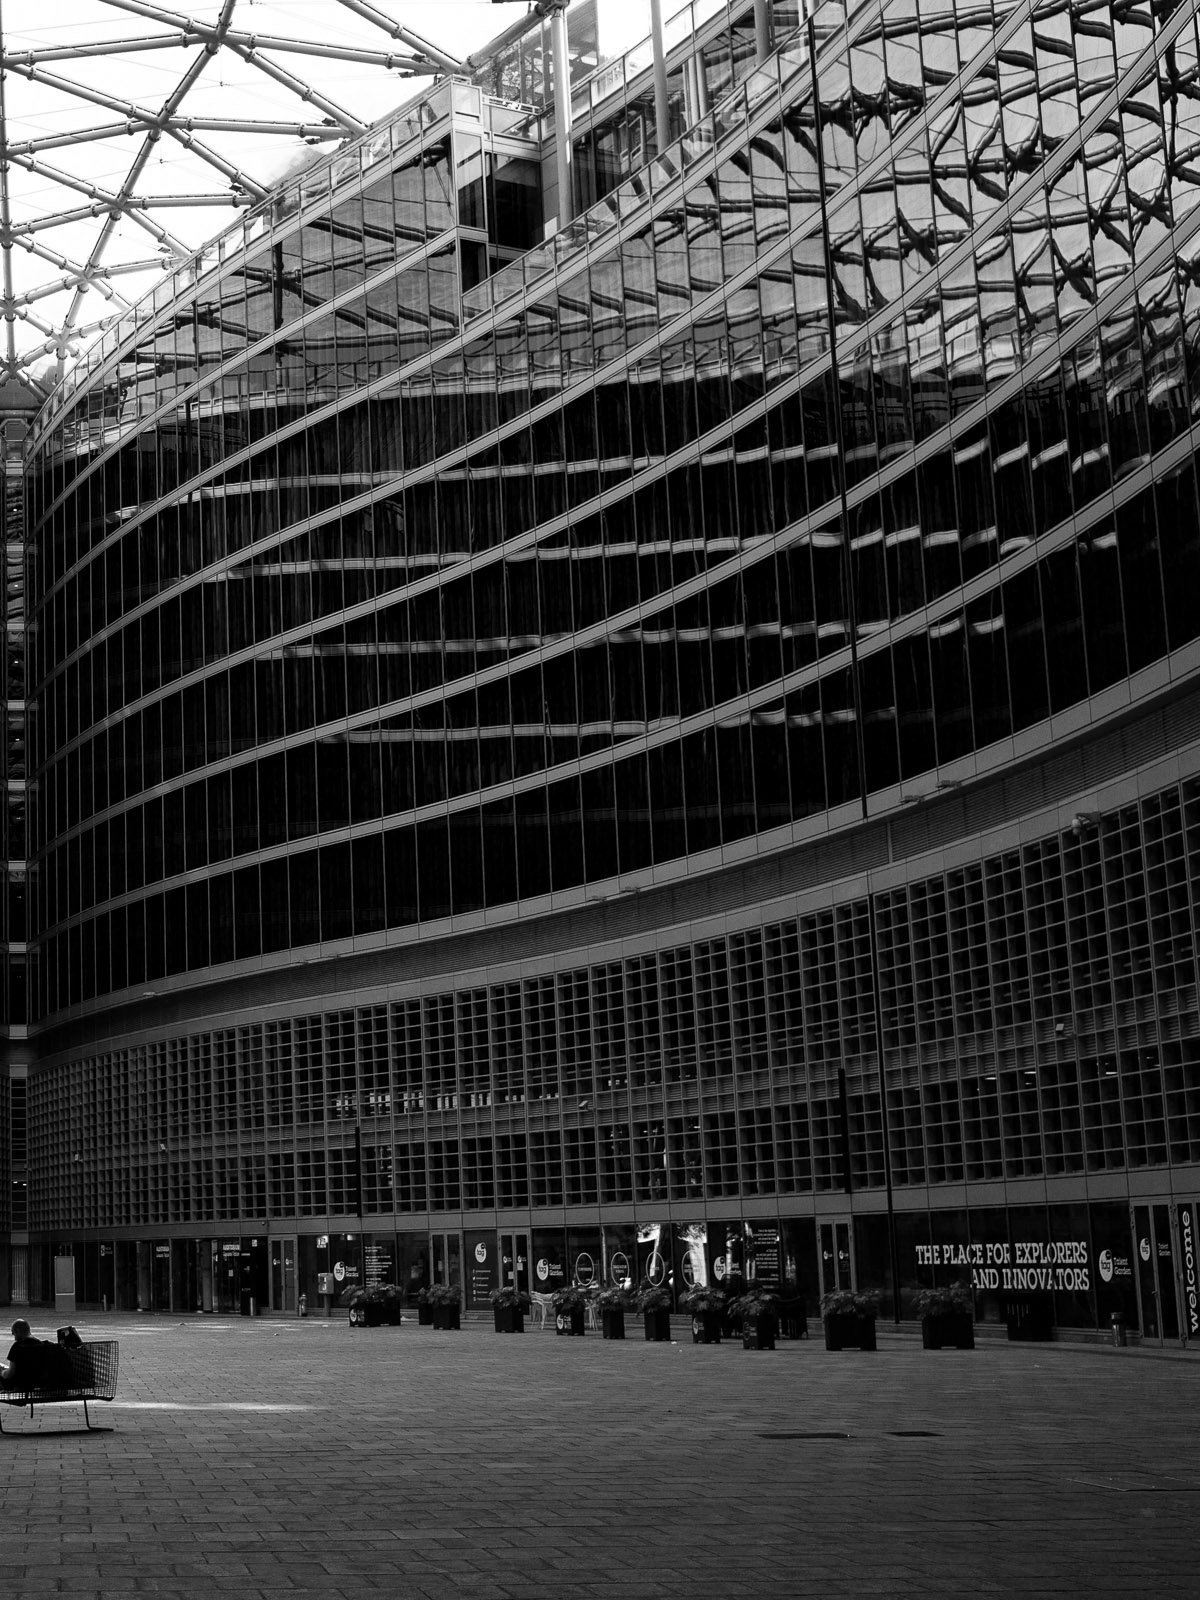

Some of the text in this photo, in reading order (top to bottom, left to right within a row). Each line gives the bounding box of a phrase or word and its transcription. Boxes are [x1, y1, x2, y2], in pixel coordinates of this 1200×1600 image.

[915, 1241, 1088, 1265] THE PLACE FOR EXPLORERS
[1113, 1257, 1128, 1266] Talent
[970, 1268, 1090, 1291] AND INNOVATORS
[1114, 1266, 1132, 1275] Garden
[1182, 1210, 1199, 1333] welcome
